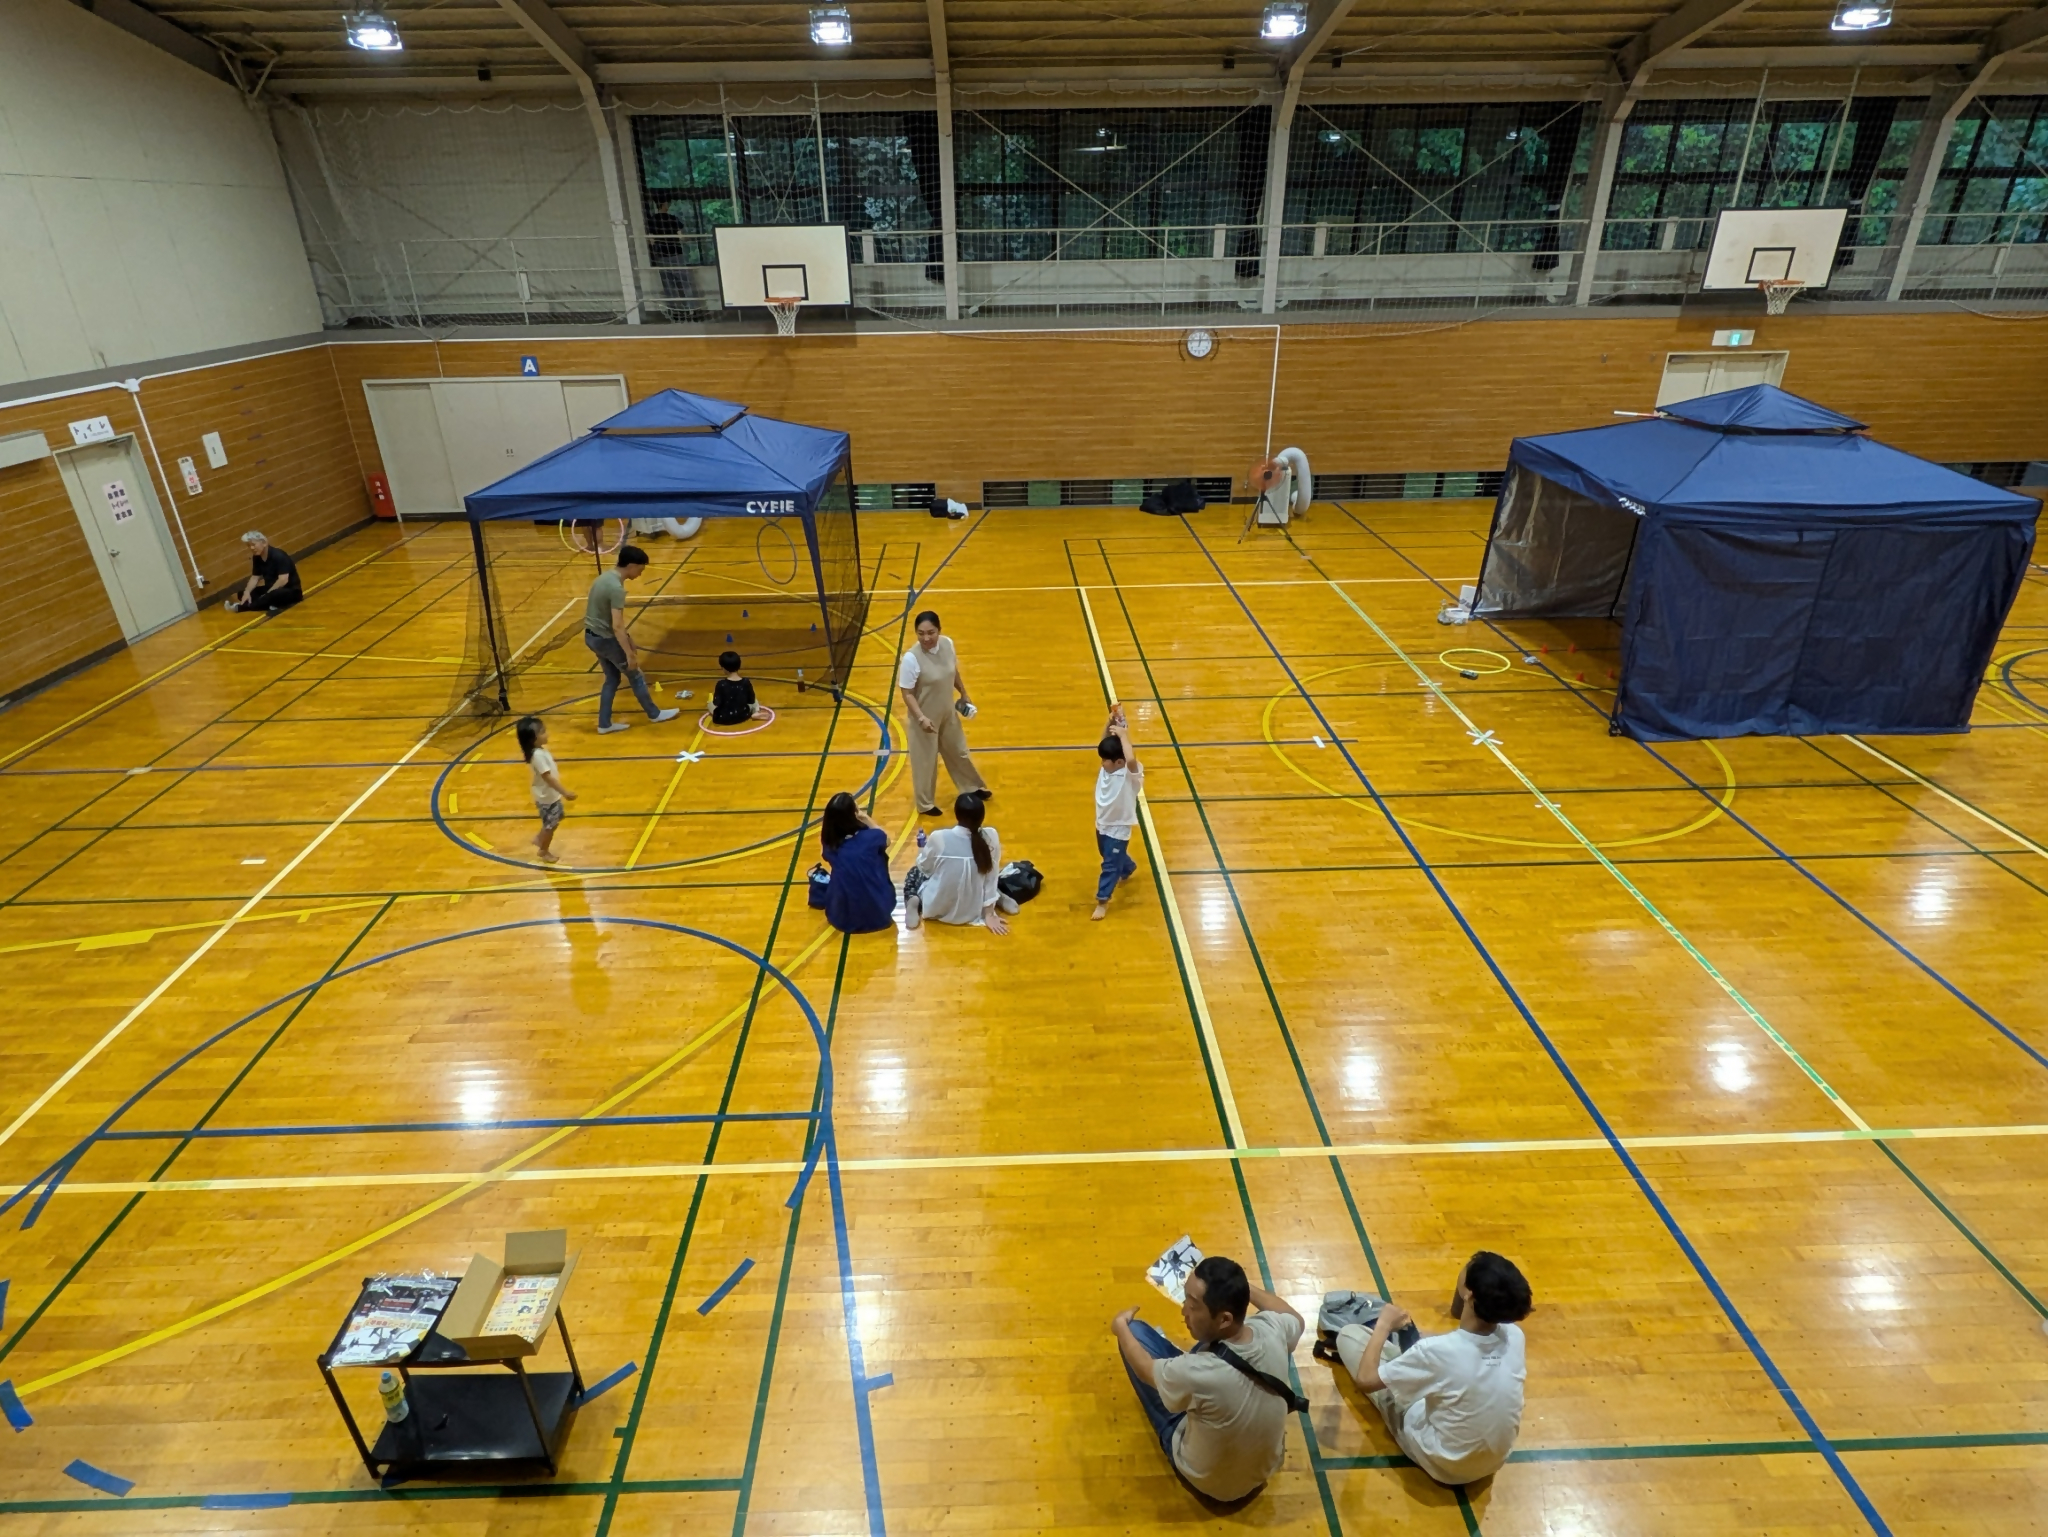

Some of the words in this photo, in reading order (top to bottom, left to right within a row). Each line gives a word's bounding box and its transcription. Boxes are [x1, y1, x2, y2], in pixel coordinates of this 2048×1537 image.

[524, 358, 537, 373] A
[73, 421, 106, 436] トイレ
[746, 499, 795, 514] CYFIE
